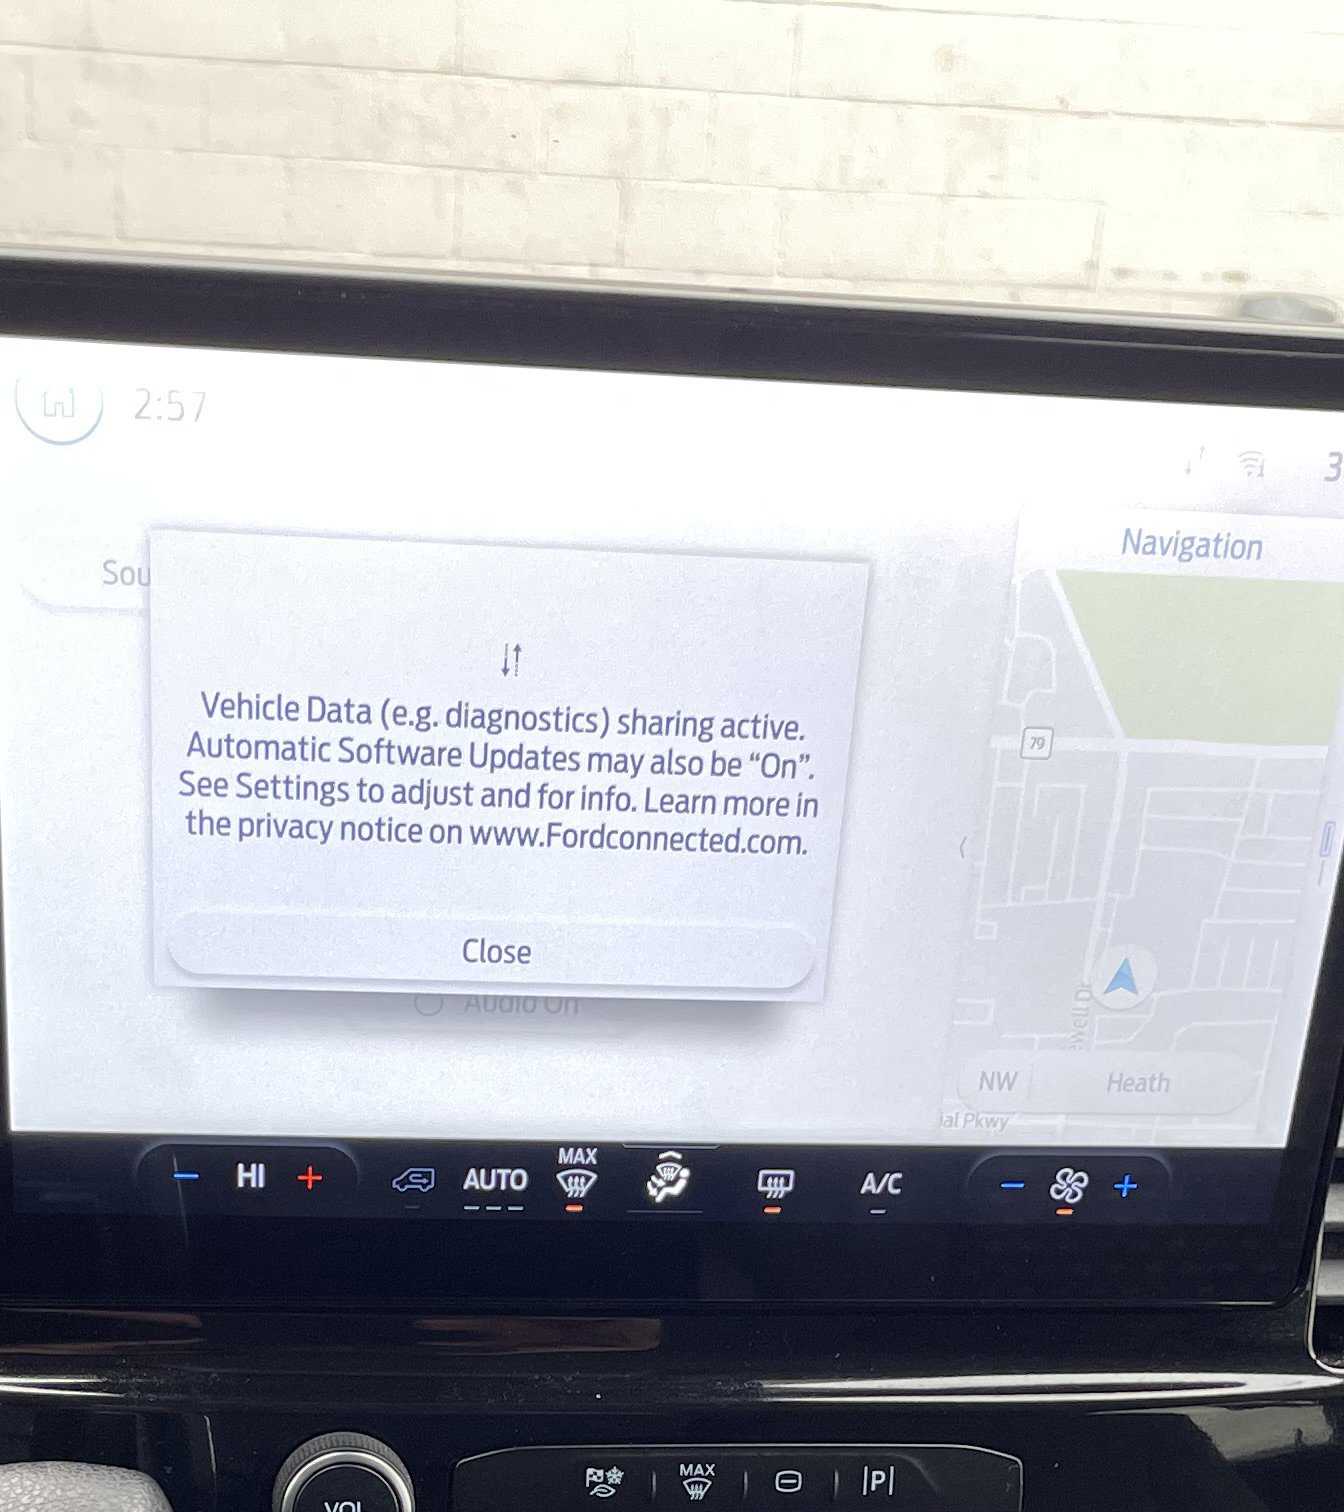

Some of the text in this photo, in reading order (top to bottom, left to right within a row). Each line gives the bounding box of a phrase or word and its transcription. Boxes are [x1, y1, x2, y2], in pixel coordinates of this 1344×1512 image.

[134, 387, 206, 423] 2:57
[1121, 527, 1263, 563] Navigation
[200, 691, 805, 743] Vehicle Data (e.g. diagnostics) sharing active.
[186, 730, 331, 763] Automatic
[337, 736, 463, 768] Software
[469, 741, 581, 774] Updates
[587, 752, 645, 779] may
[650, 747, 704, 777] also
[710, 749, 742, 778] be
[1030, 735, 1046, 750] 79
[178, 769, 819, 818] See Settings to adjust and for info. Learn more in
[185, 808, 808, 856] the privacy notice on www.Fordconnected.com.
[462, 937, 532, 965] Close
[978, 1070, 1019, 1092] NW
[1106, 1071, 1171, 1094] Heath
[962, 1111, 1009, 1132] Pkwy
[558, 1147, 598, 1165] MAX
[237, 1162, 265, 1188] HI
[462, 1167, 528, 1191] AUTO
[859, 1172, 903, 1195] A/C
[679, 1463, 716, 1478] MAX
